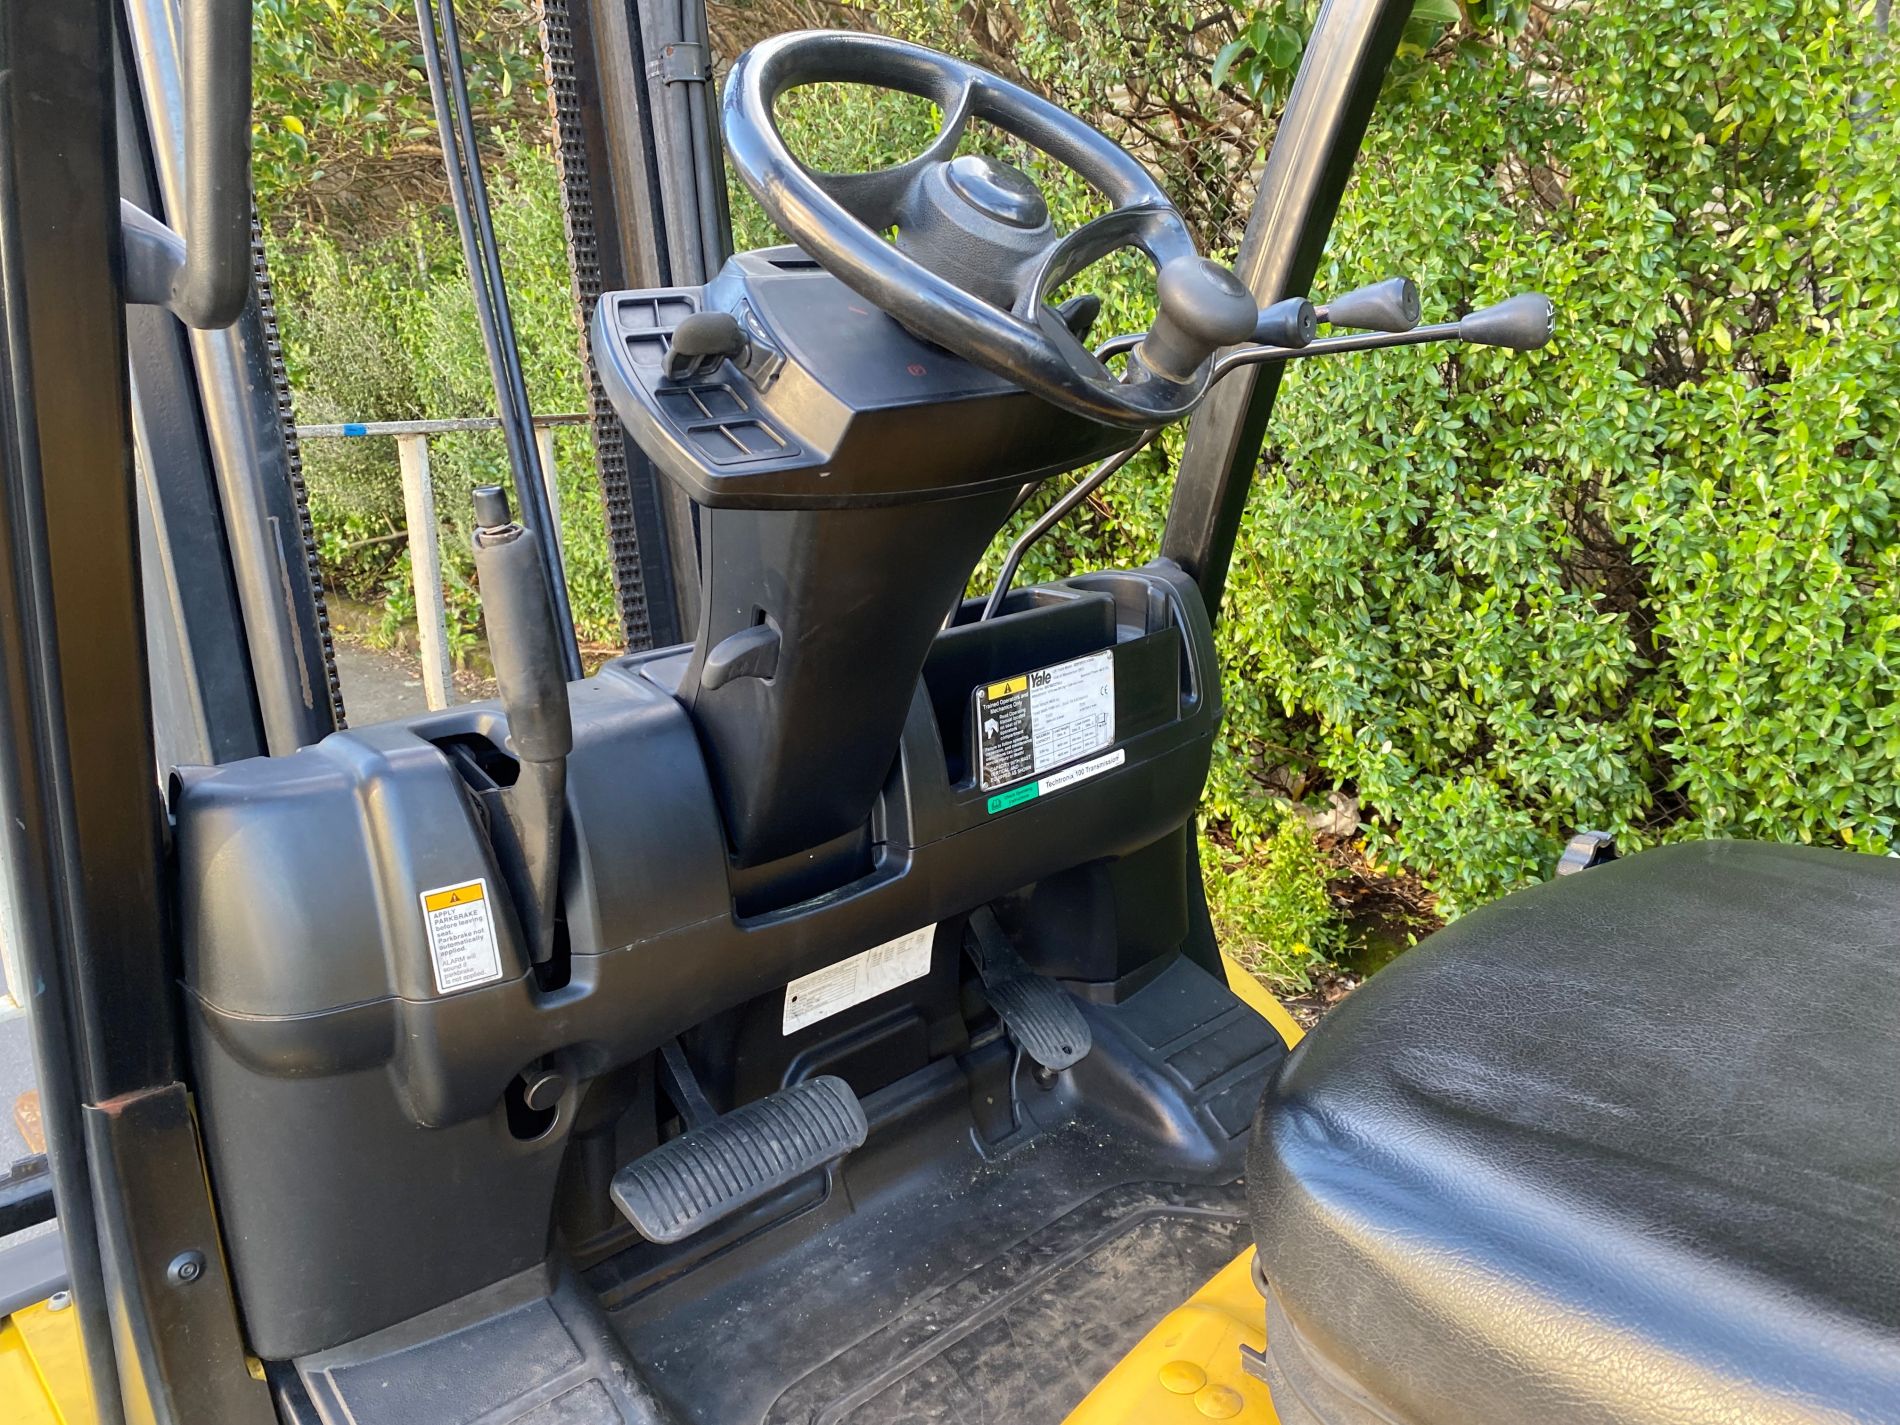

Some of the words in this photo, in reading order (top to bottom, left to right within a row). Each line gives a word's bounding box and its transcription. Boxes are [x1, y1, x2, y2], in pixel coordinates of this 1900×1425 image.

[1031, 670, 1052, 689] Yale
[983, 701, 999, 710] Trained
[990, 703, 1012, 714] Mechanics
[1046, 774, 1073, 789] Techtronix
[1076, 768, 1084, 777] 100
[1086, 756, 1119, 773] Transmission
[434, 909, 456, 919] APPLY
[434, 910, 478, 925] PARKBRAKE
[436, 923, 458, 932] before
[458, 915, 483, 926] leaving
[437, 930, 453, 938] seat.
[438, 931, 472, 944] Parkbrake
[439, 934, 484, 951] automatically
[442, 956, 465, 966] ALARM
[443, 963, 463, 973] sound
[444, 967, 474, 979] parkbrake
